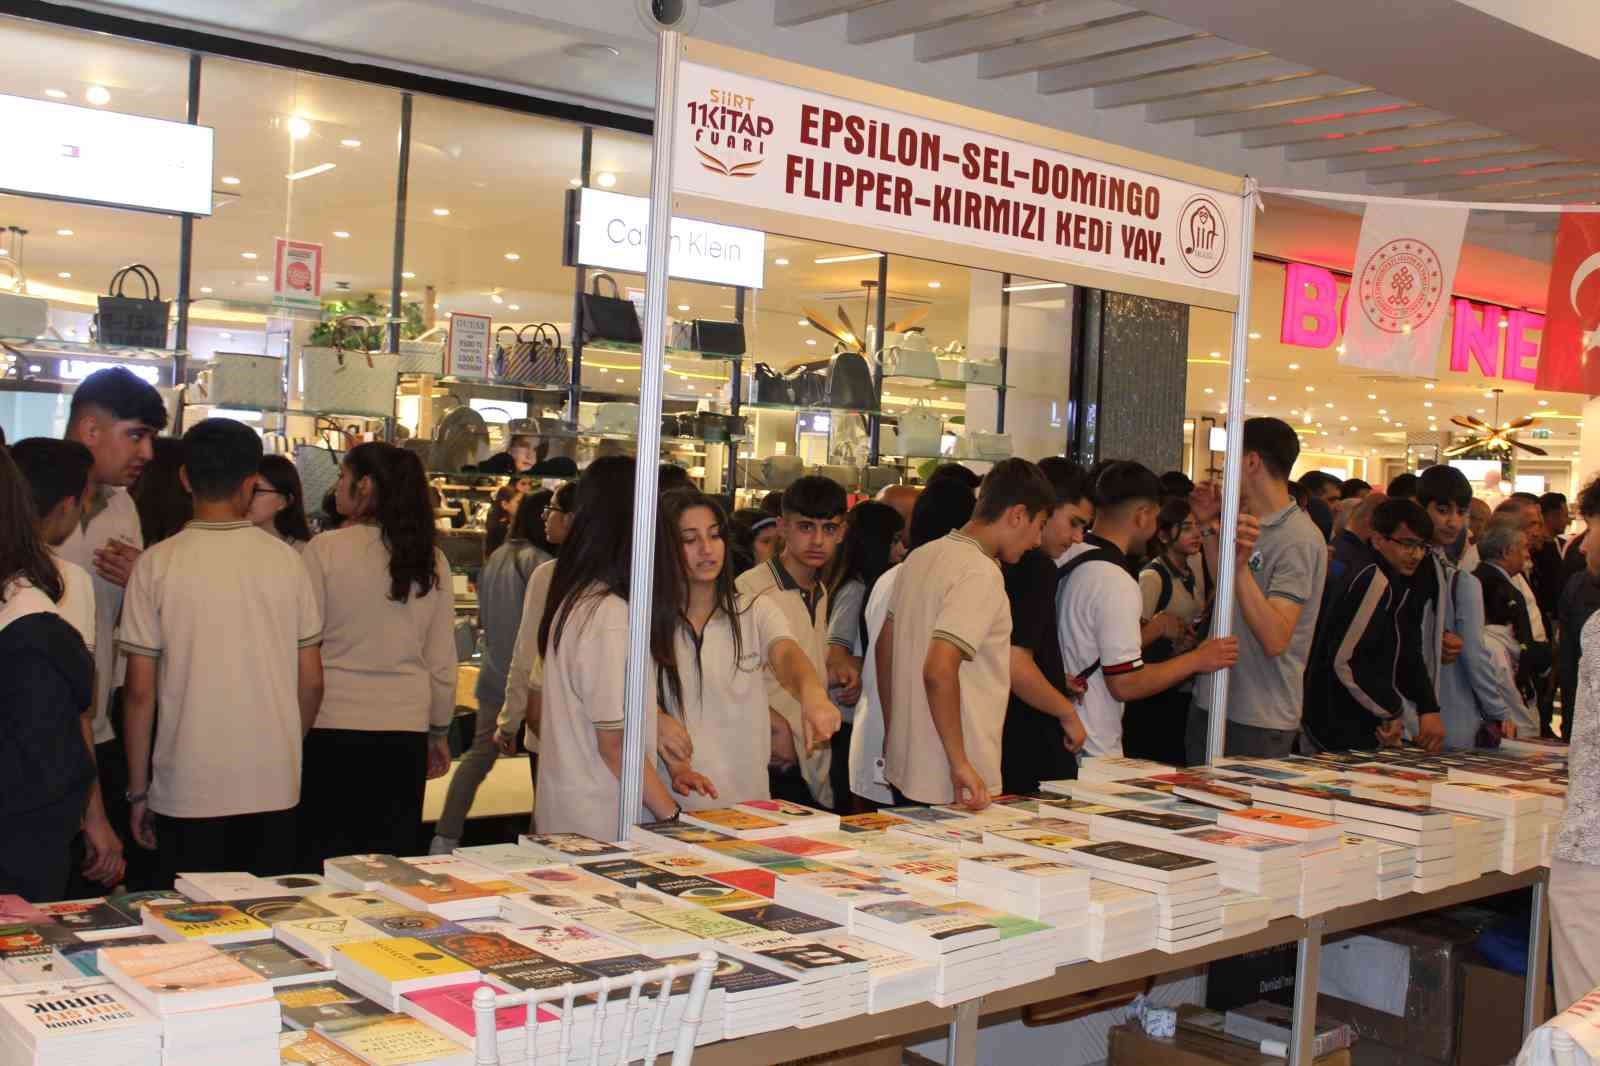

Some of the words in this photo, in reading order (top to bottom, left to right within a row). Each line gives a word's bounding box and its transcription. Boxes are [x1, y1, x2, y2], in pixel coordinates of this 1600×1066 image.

[695, 129, 764, 155] FUARI
[688, 231, 742, 262] Klein
[1122, 225, 1166, 266] YAY.
[26, 993, 117, 1014] BIRAK
